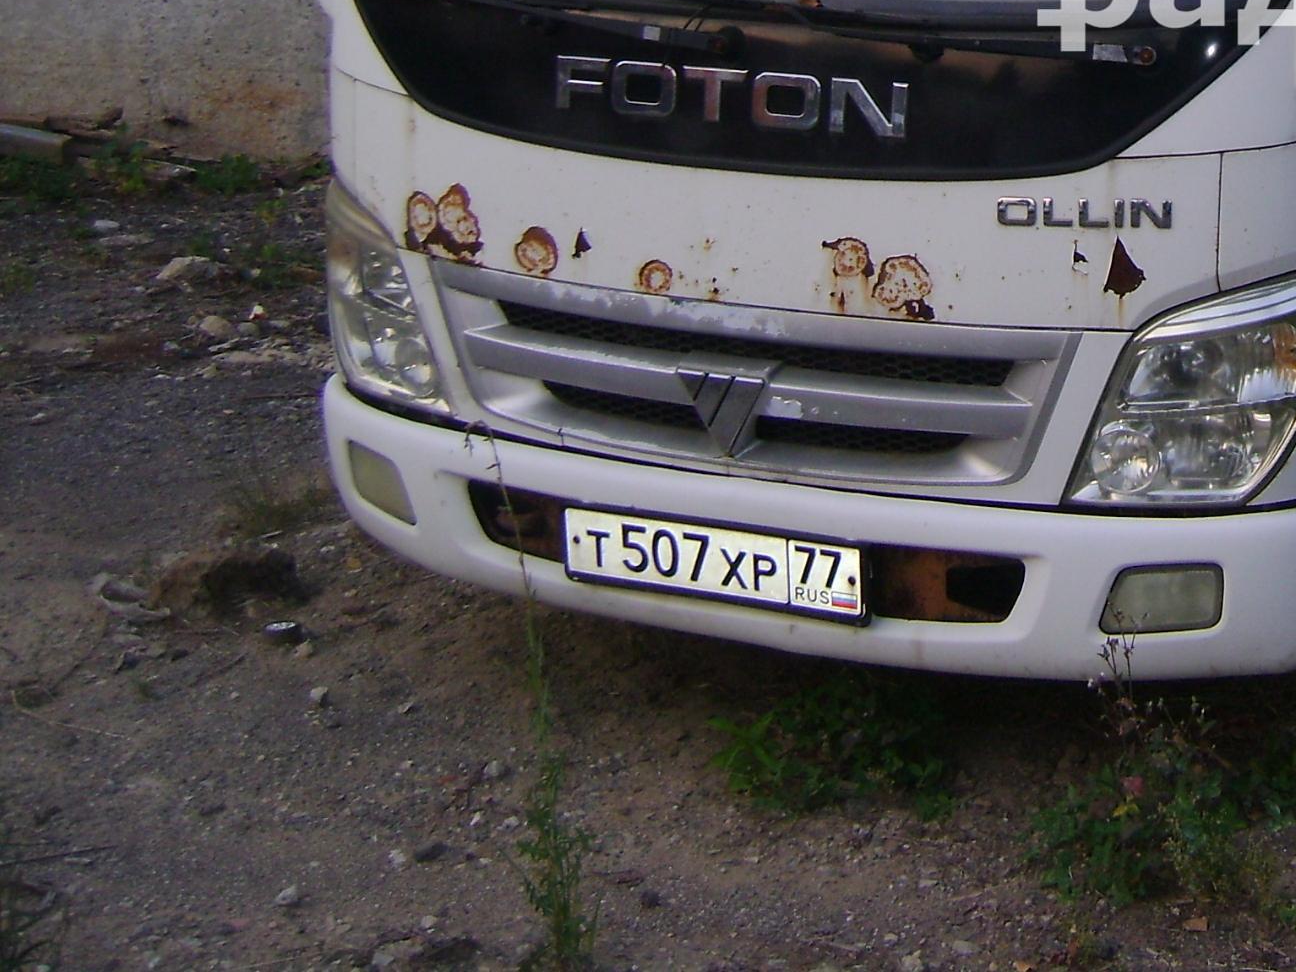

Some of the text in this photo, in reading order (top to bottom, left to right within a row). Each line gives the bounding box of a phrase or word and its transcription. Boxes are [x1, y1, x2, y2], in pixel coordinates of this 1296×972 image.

[555, 54, 910, 138] FOTON
[996, 196, 1173, 229] OLLIN
[793, 545, 842, 589] 77
[795, 586, 830, 605] RUS
